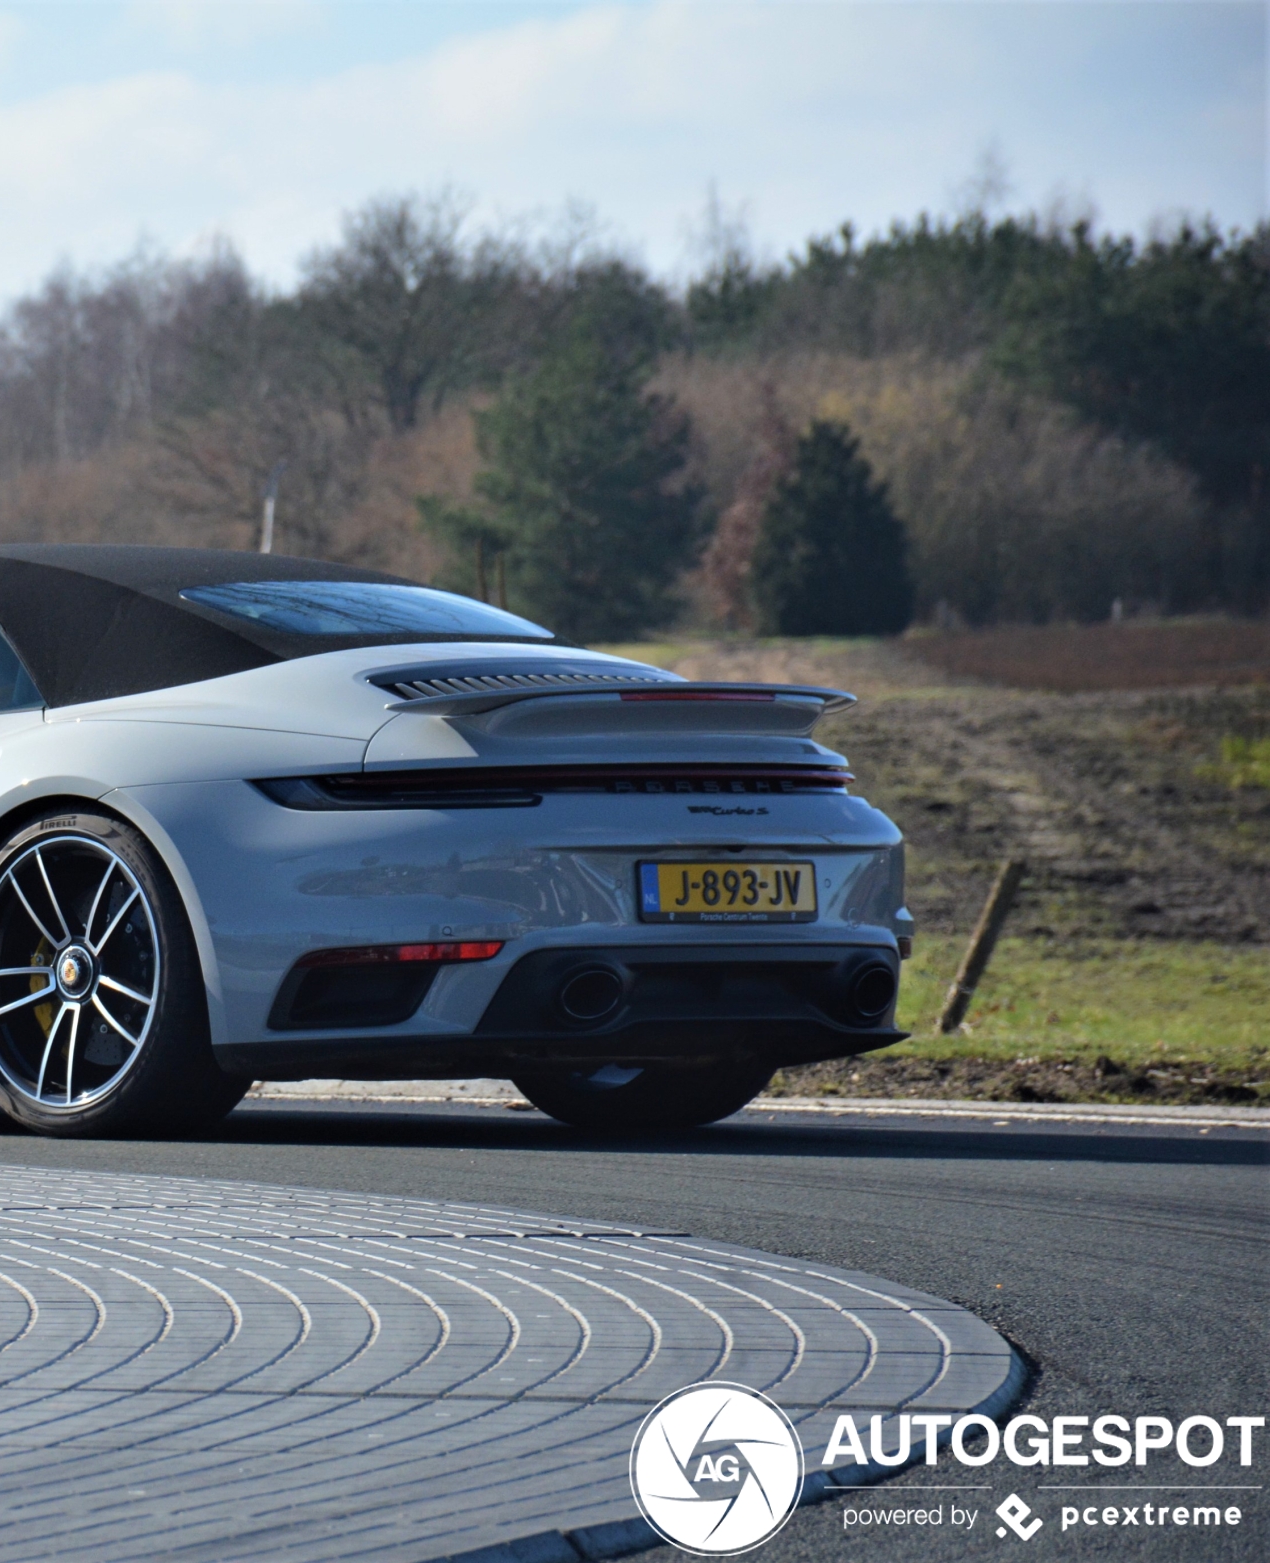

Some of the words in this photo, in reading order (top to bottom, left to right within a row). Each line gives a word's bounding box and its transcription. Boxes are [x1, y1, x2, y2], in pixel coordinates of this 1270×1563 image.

[615, 780, 794, 793] PORSCHE
[40, 815, 77, 830] PIRELLI
[675, 869, 802, 906] J-893-JV
[645, 893, 658, 904] NL
[700, 913, 723, 921] Porsche
[723, 913, 748, 921] Centrum
[748, 913, 768, 921] Twente
